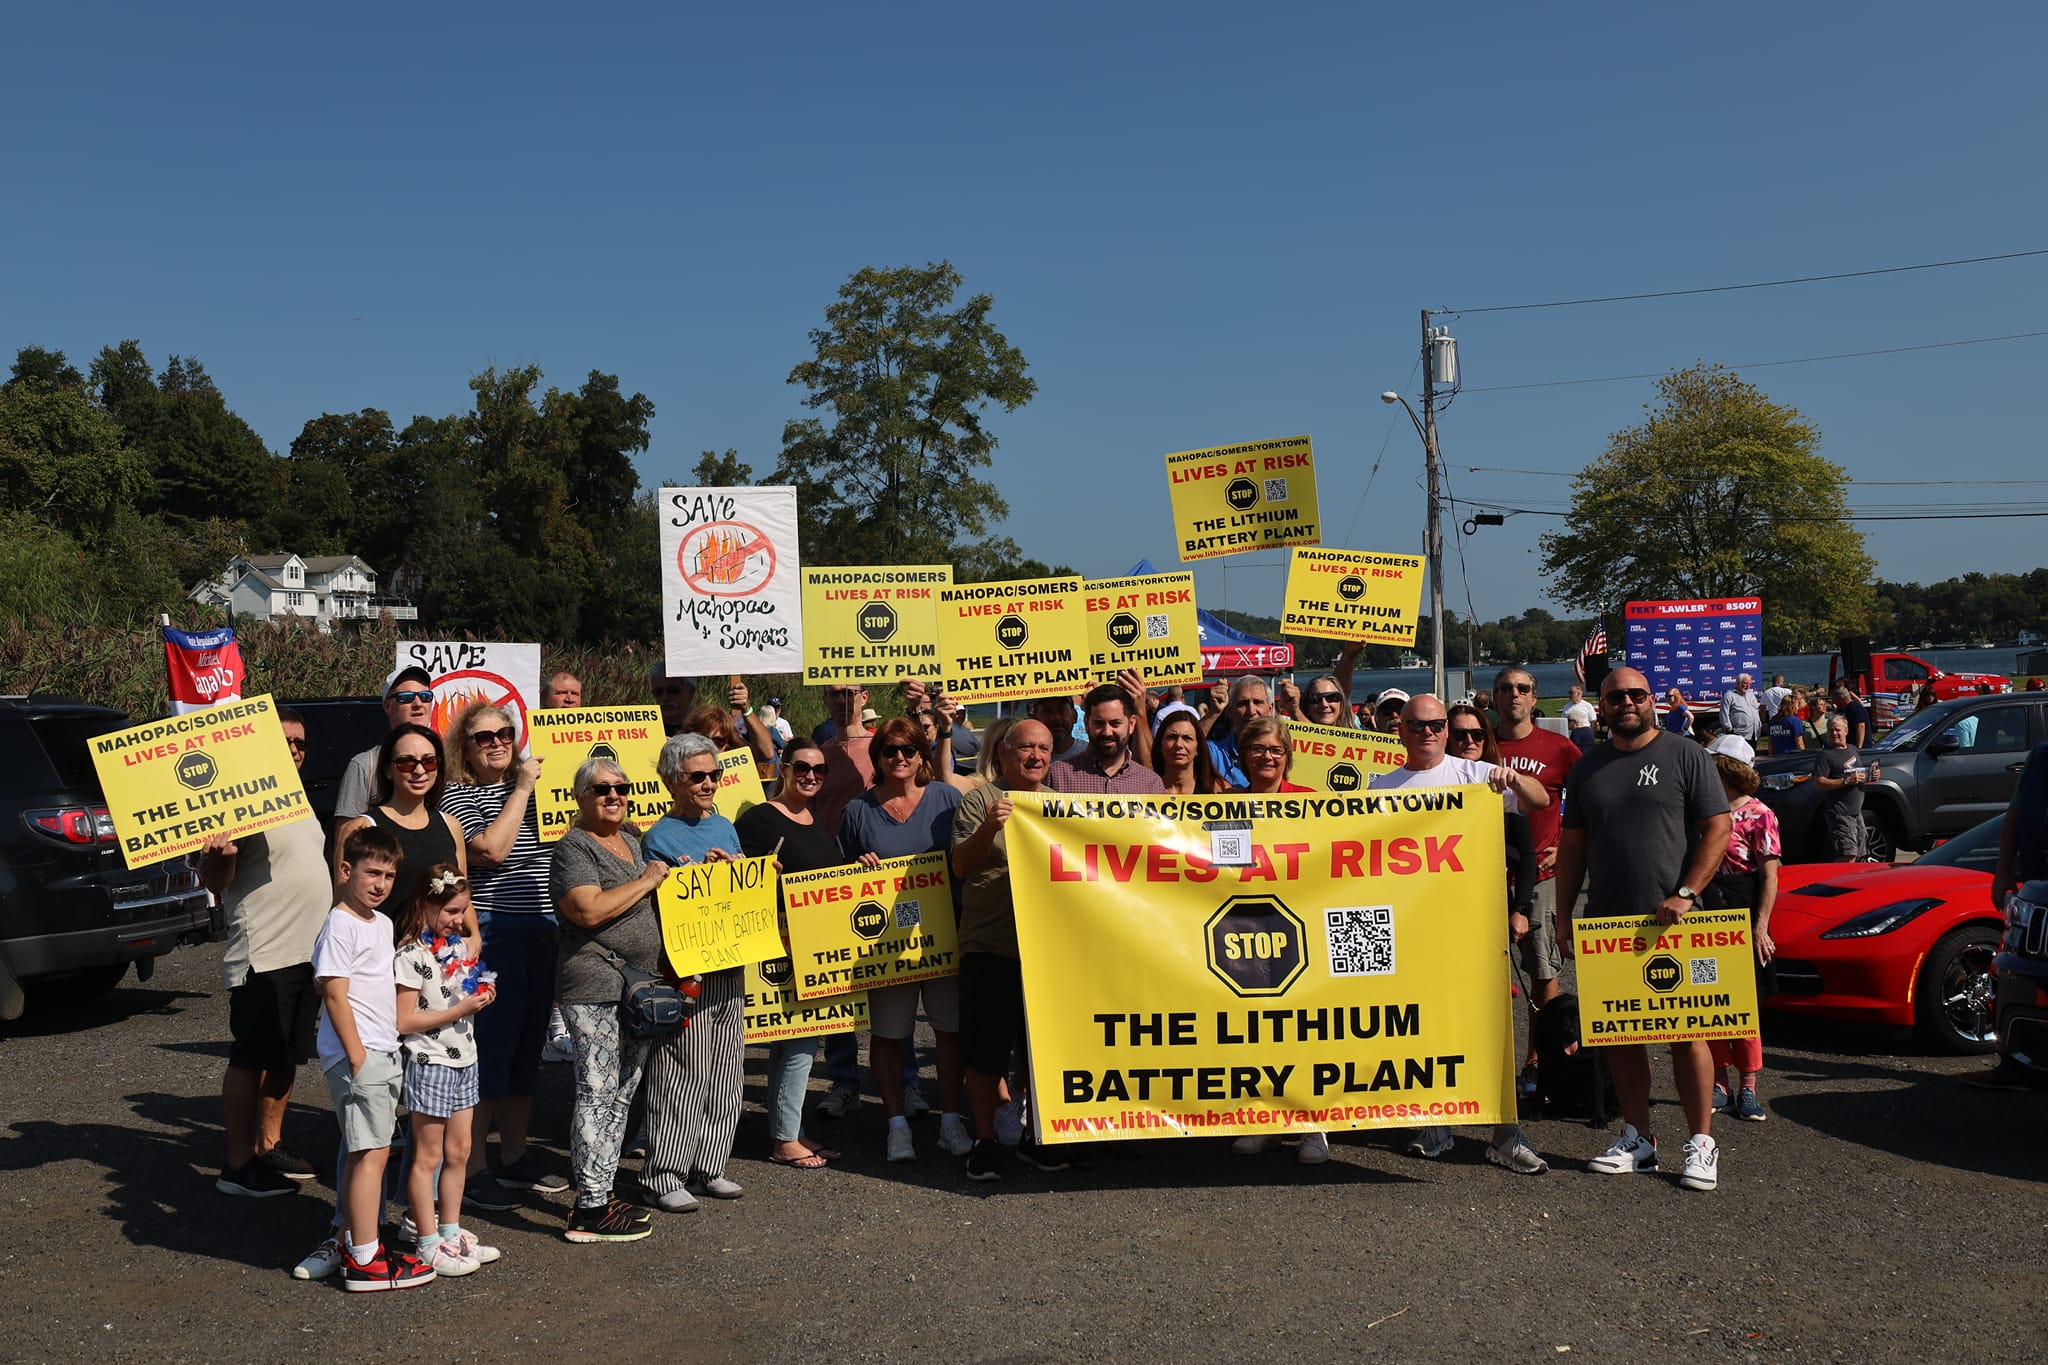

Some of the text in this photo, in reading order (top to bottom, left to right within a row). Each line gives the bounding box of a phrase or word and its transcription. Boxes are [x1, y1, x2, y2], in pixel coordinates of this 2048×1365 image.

[1168, 438, 1308, 463] MAHOPAC/SOMERS/YORKTOWN
[1172, 453, 1310, 483] LIVES AT RISK
[1232, 489, 1252, 500] STOP
[1193, 509, 1298, 533] THE LITHIUM
[1186, 525, 1315, 551] BATTERY PLANT
[1183, 539, 1320, 561] www.lithiumbatteryawareness.com
[1298, 551, 1419, 567] MAHOPAC/SOMERS
[809, 572, 946, 584] MAHOPAC/SOMERS
[1310, 564, 1403, 579] LIVES AT RISK
[825, 588, 931, 600] LIVES AT RISK
[941, 582, 1078, 601] MAHOPAC/SOMERS
[1343, 584, 1361, 592] STOP
[959, 600, 1064, 617] LIVES AT RISK
[1117, 594, 1140, 608] AT
[1146, 589, 1191, 606] RISK
[1631, 606, 1656, 614] TEXT
[1726, 602, 1757, 610] 85007
[677, 595, 775, 630] Mahopac
[1299, 600, 1401, 618] THE LITHIUM
[864, 617, 890, 628] STOP
[1002, 627, 1022, 637] STOP
[1113, 625, 1134, 635] STOP
[1286, 614, 1414, 635] BATTERY PLANT
[720, 624, 788, 651] Somers
[1285, 626, 1413, 643] www.lithiumbatteryawareness.com
[410, 644, 486, 673] SAVE
[819, 645, 935, 658] THE LITHIUM
[956, 649, 1072, 670] THE LITHIUM
[1111, 646, 1179, 663] LITHIUM
[808, 664, 941, 678] BATTERY PLAN
[947, 673, 1027, 692] BATTERY
[1034, 668, 1089, 684] PLANT
[1144, 662, 1196, 678] PLANT
[97, 701, 268, 753] MAHOPAC/SOMERS
[533, 710, 658, 727] MAHOPAC/SOMERS
[124, 723, 256, 767] LIVES AT RISK
[552, 728, 648, 744] LIVES AT RISK
[1292, 739, 1408, 766] IVES AT RIS
[183, 763, 209, 778] STOP
[1334, 774, 1355, 785] STOP
[133, 775, 278, 825] THE LITHIUM
[551, 787, 575, 802] TH
[627, 801, 674, 818] PLANT
[1043, 792, 1463, 820] MAHOPAC/SOMERS/YORKTOWN
[126, 791, 303, 852] BATTERY PLANT
[1050, 835, 1464, 882] LIVES AT RISK
[677, 859, 766, 900] SAY NO!
[785, 855, 943, 885] MAHOPAC/SOMERS/YORKTOWN
[790, 871, 944, 908] LIVES AT RISK
[698, 902, 731, 916] TO THE
[669, 919, 726, 952] LITHIUM
[733, 907, 775, 938] BATTERY
[858, 914, 881, 927] STOP
[813, 934, 934, 964] THE LITHIUM
[1224, 932, 1287, 960] STOP
[1582, 931, 1746, 954] LIVES AT RISK
[701, 943, 743, 968] PLANT
[766, 962, 788, 974] STOP
[805, 952, 953, 987] BATTERY PLANT
[1651, 968, 1675, 980] STOP
[1602, 994, 1730, 1012] THE LITHIUM
[744, 1003, 866, 1028] TERY PLANT
[1094, 1004, 1420, 1046] THE LITHIUM
[1592, 1013, 1750, 1033] BATTERY PLANT
[1588, 1029, 1756, 1044] www.lithiumbatteryawareness.com
[1063, 1055, 1465, 1103] BATTERY PLANT
[1051, 1099, 1480, 1133] www.lithiumbatteryawareness.com
